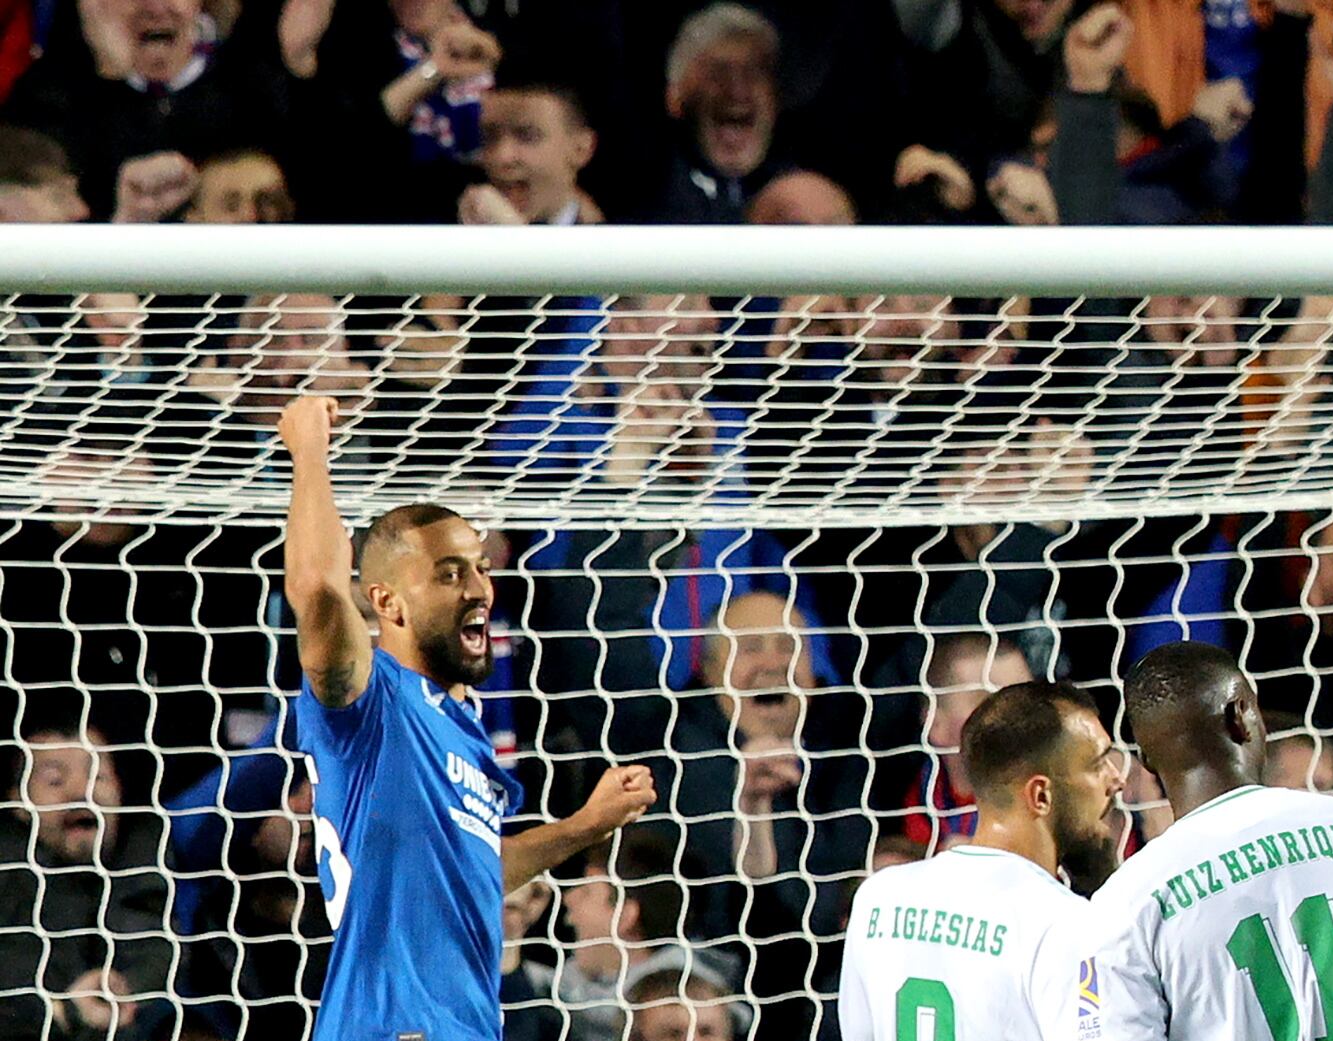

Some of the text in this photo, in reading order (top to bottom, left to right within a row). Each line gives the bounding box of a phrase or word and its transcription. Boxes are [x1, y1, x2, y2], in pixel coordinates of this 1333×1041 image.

[1151, 861, 1223, 920] LUIZ
[866, 906, 1008, 956] B. IGLESIAS
